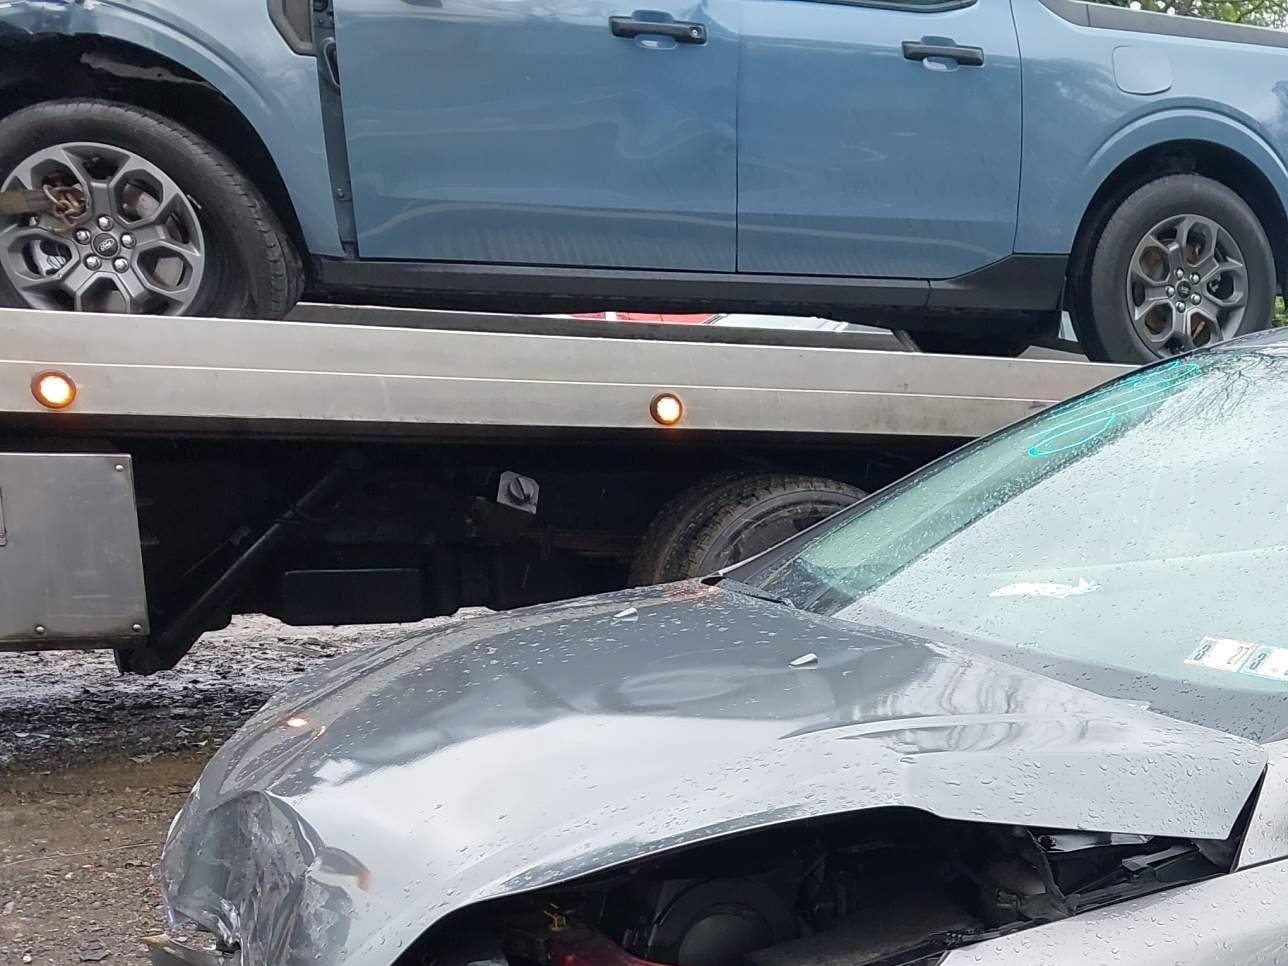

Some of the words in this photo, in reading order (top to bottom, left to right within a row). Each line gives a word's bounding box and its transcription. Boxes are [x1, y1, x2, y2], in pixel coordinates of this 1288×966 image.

[1193, 643, 1212, 661] 3
[1226, 646, 1250, 665] 27
[1249, 652, 1267, 670] 3
